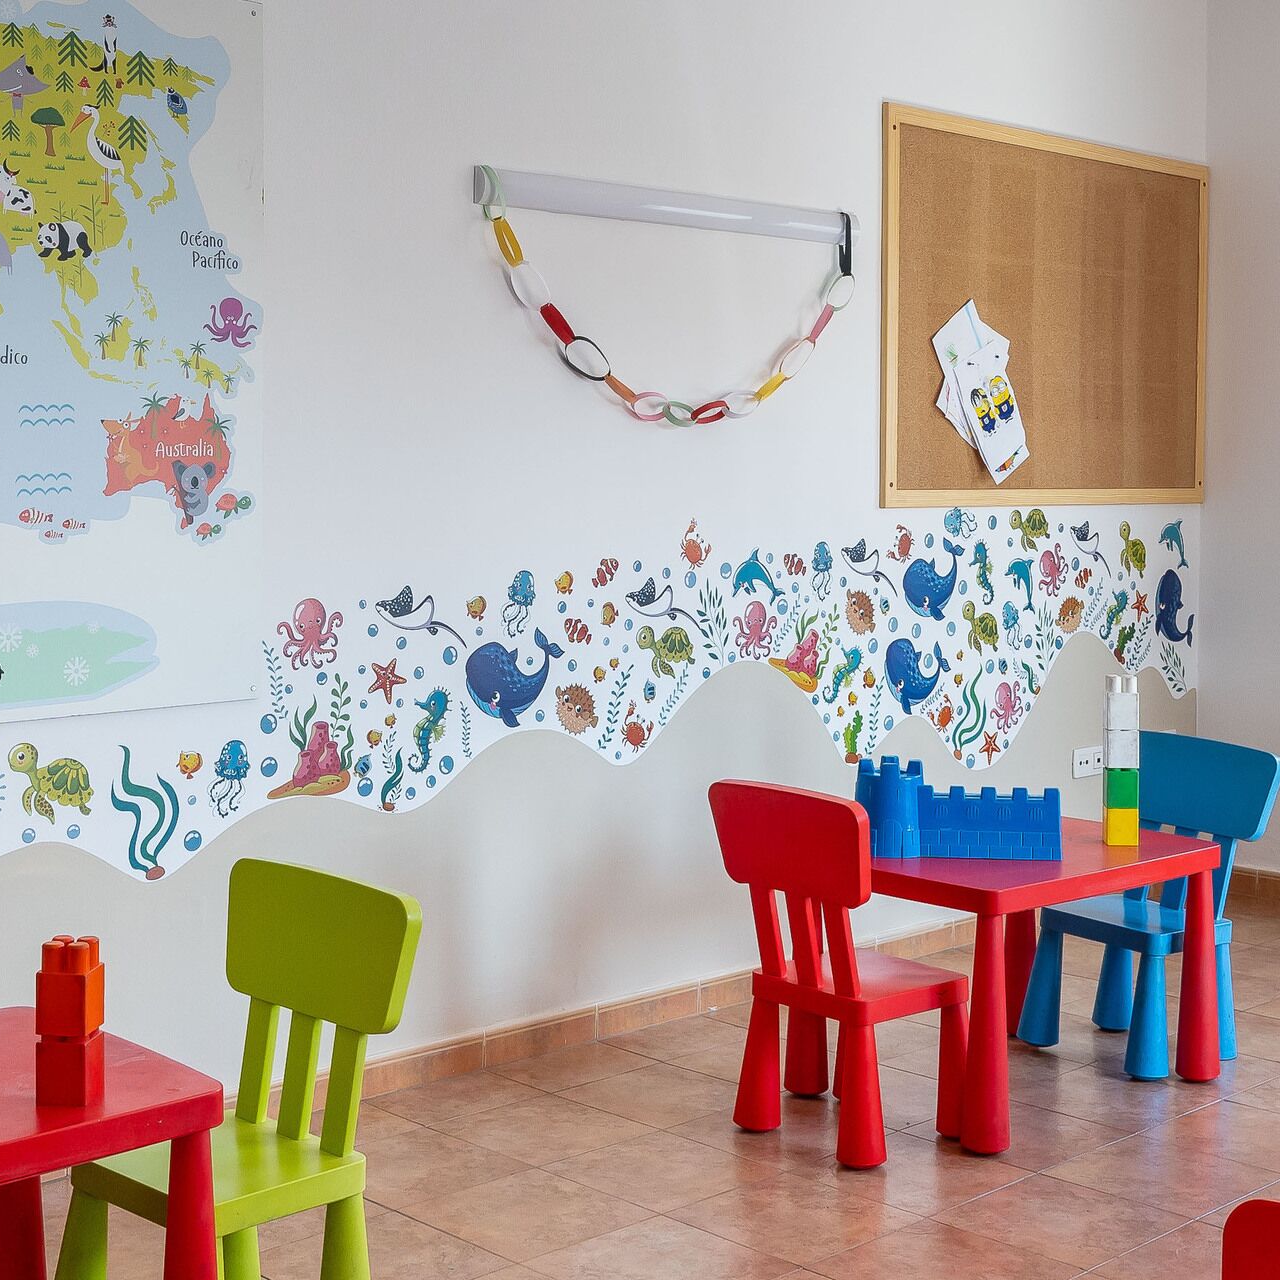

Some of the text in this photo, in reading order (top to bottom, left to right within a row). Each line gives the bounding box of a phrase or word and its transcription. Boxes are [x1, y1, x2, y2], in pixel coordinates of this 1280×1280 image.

[180, 230, 224, 248] Océano
[192, 249, 239, 270] Pacífico
[155, 438, 214, 459] Australia
